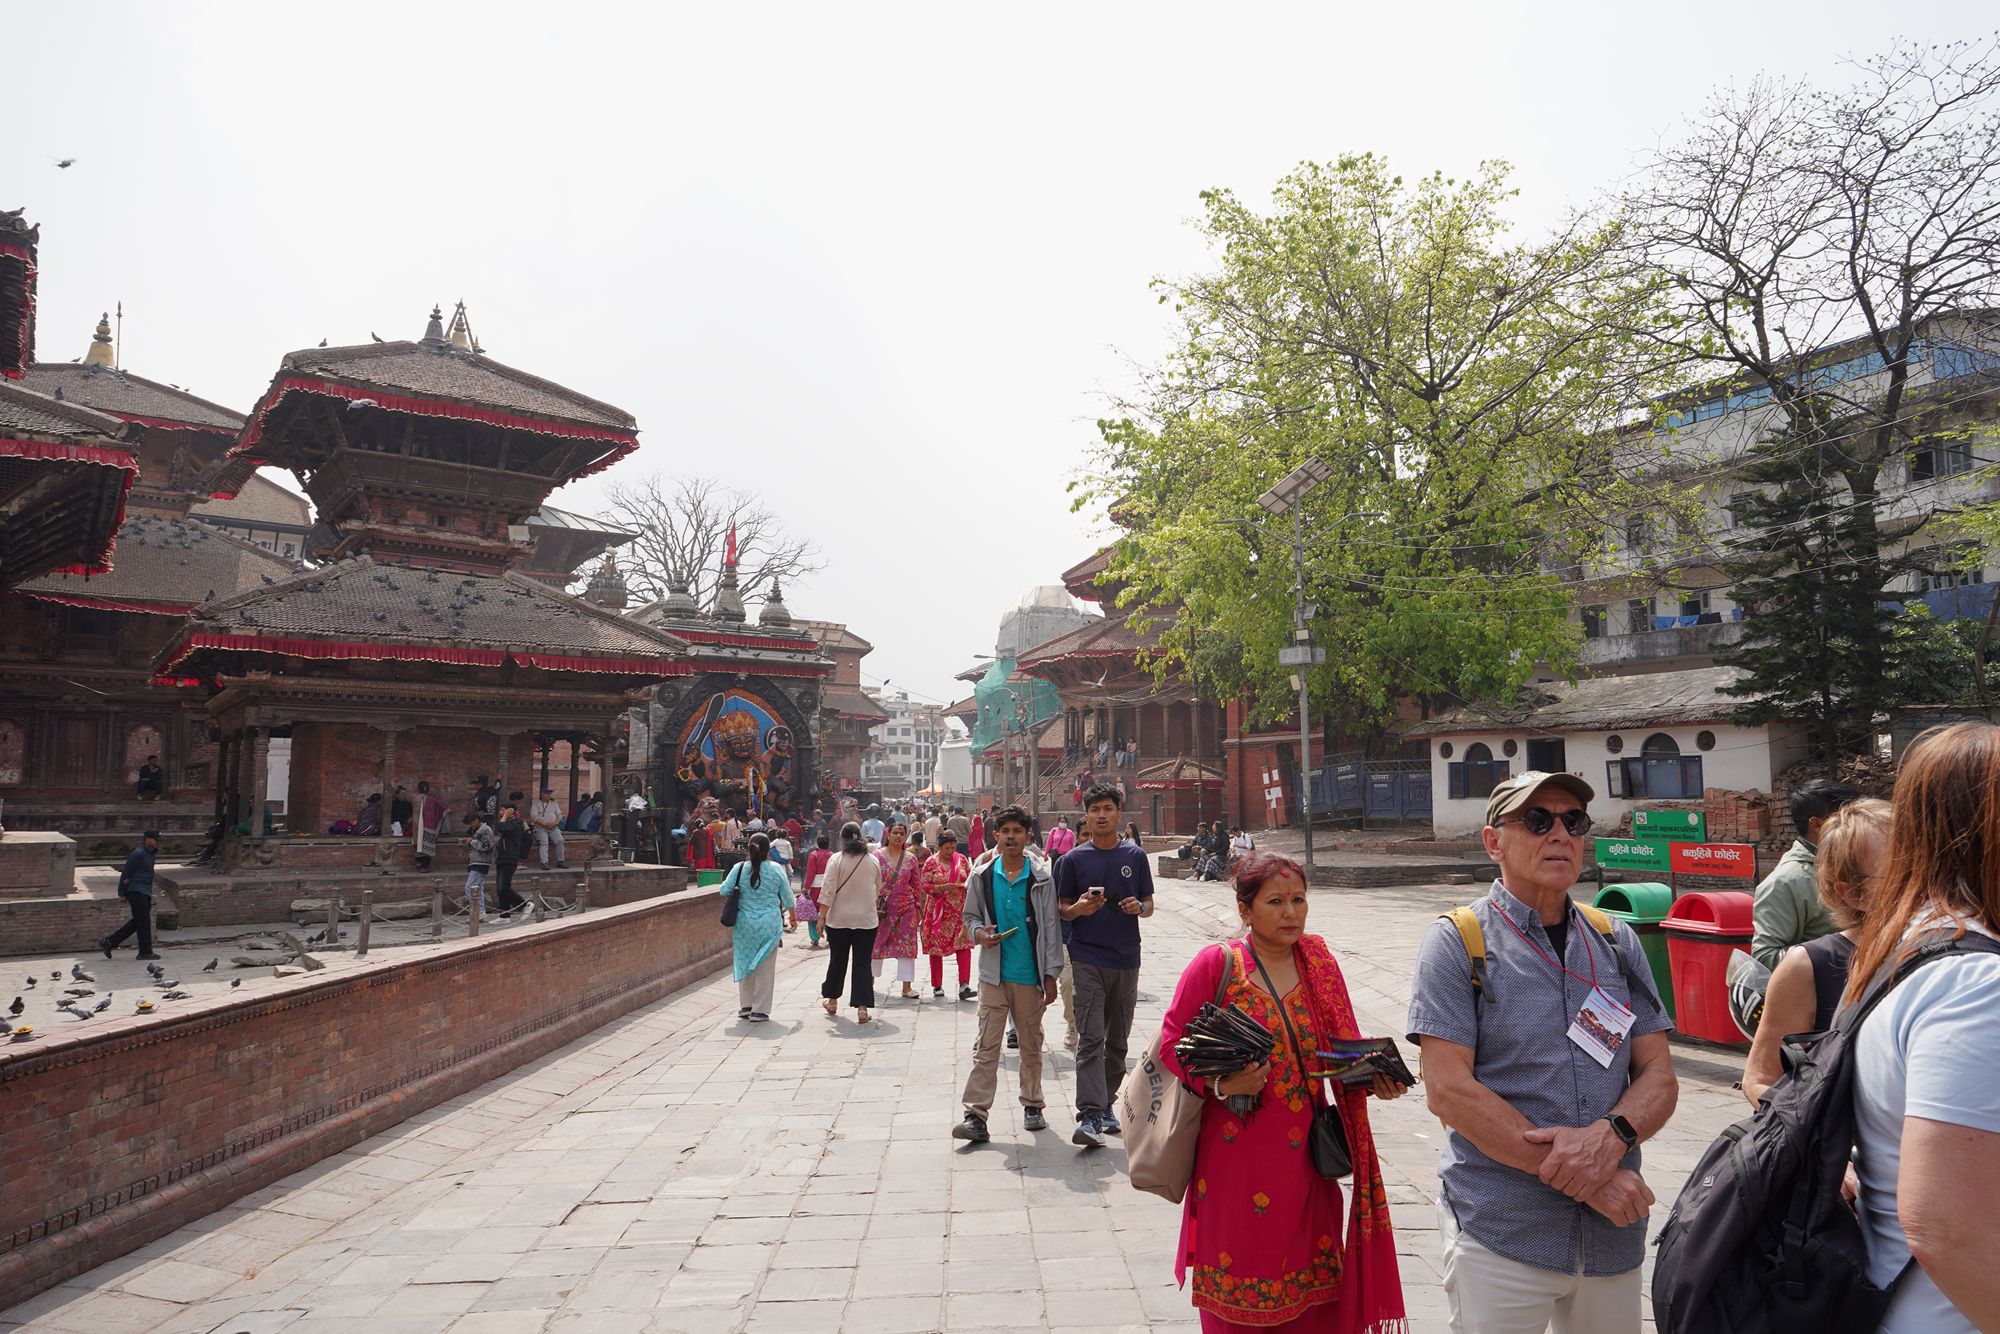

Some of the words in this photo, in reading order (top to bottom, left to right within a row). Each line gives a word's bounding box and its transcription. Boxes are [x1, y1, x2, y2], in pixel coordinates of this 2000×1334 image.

[1608, 843, 1630, 856] कुहिने
[1631, 845, 1655, 856] फोहोर
[1682, 847, 1712, 860] नकुहिने
[1714, 849, 1741, 861] फोहोर
